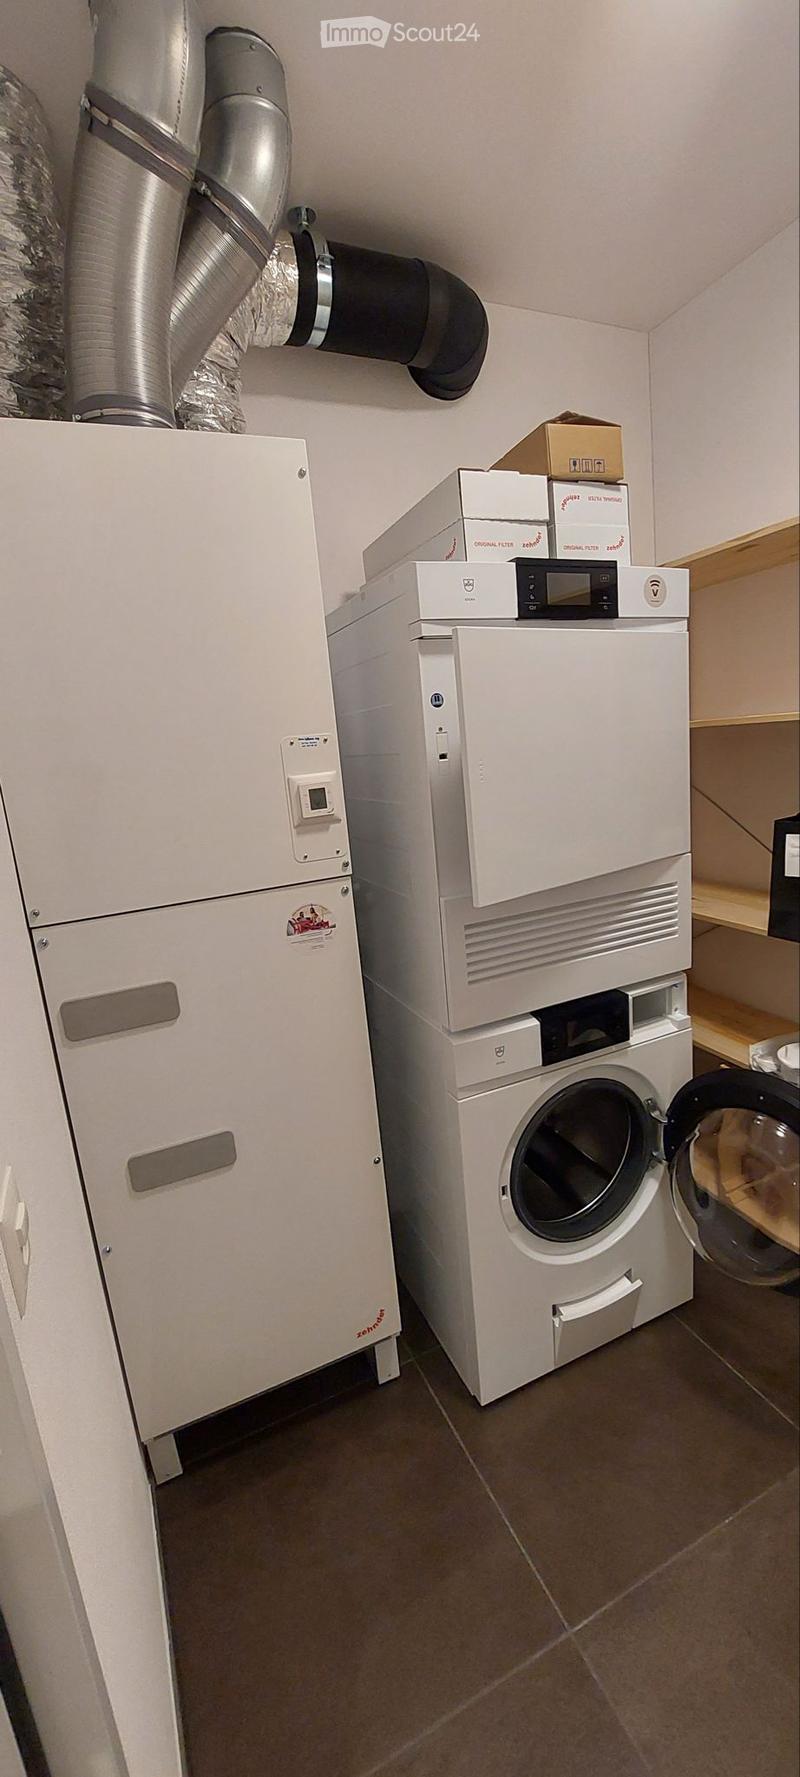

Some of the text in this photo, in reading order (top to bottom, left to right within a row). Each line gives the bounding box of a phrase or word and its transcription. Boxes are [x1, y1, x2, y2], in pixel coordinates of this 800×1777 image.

[522, 531, 542, 549] zehnder
[606, 535, 624, 551] zehnder
[356, 1309, 385, 1339] zehnder
